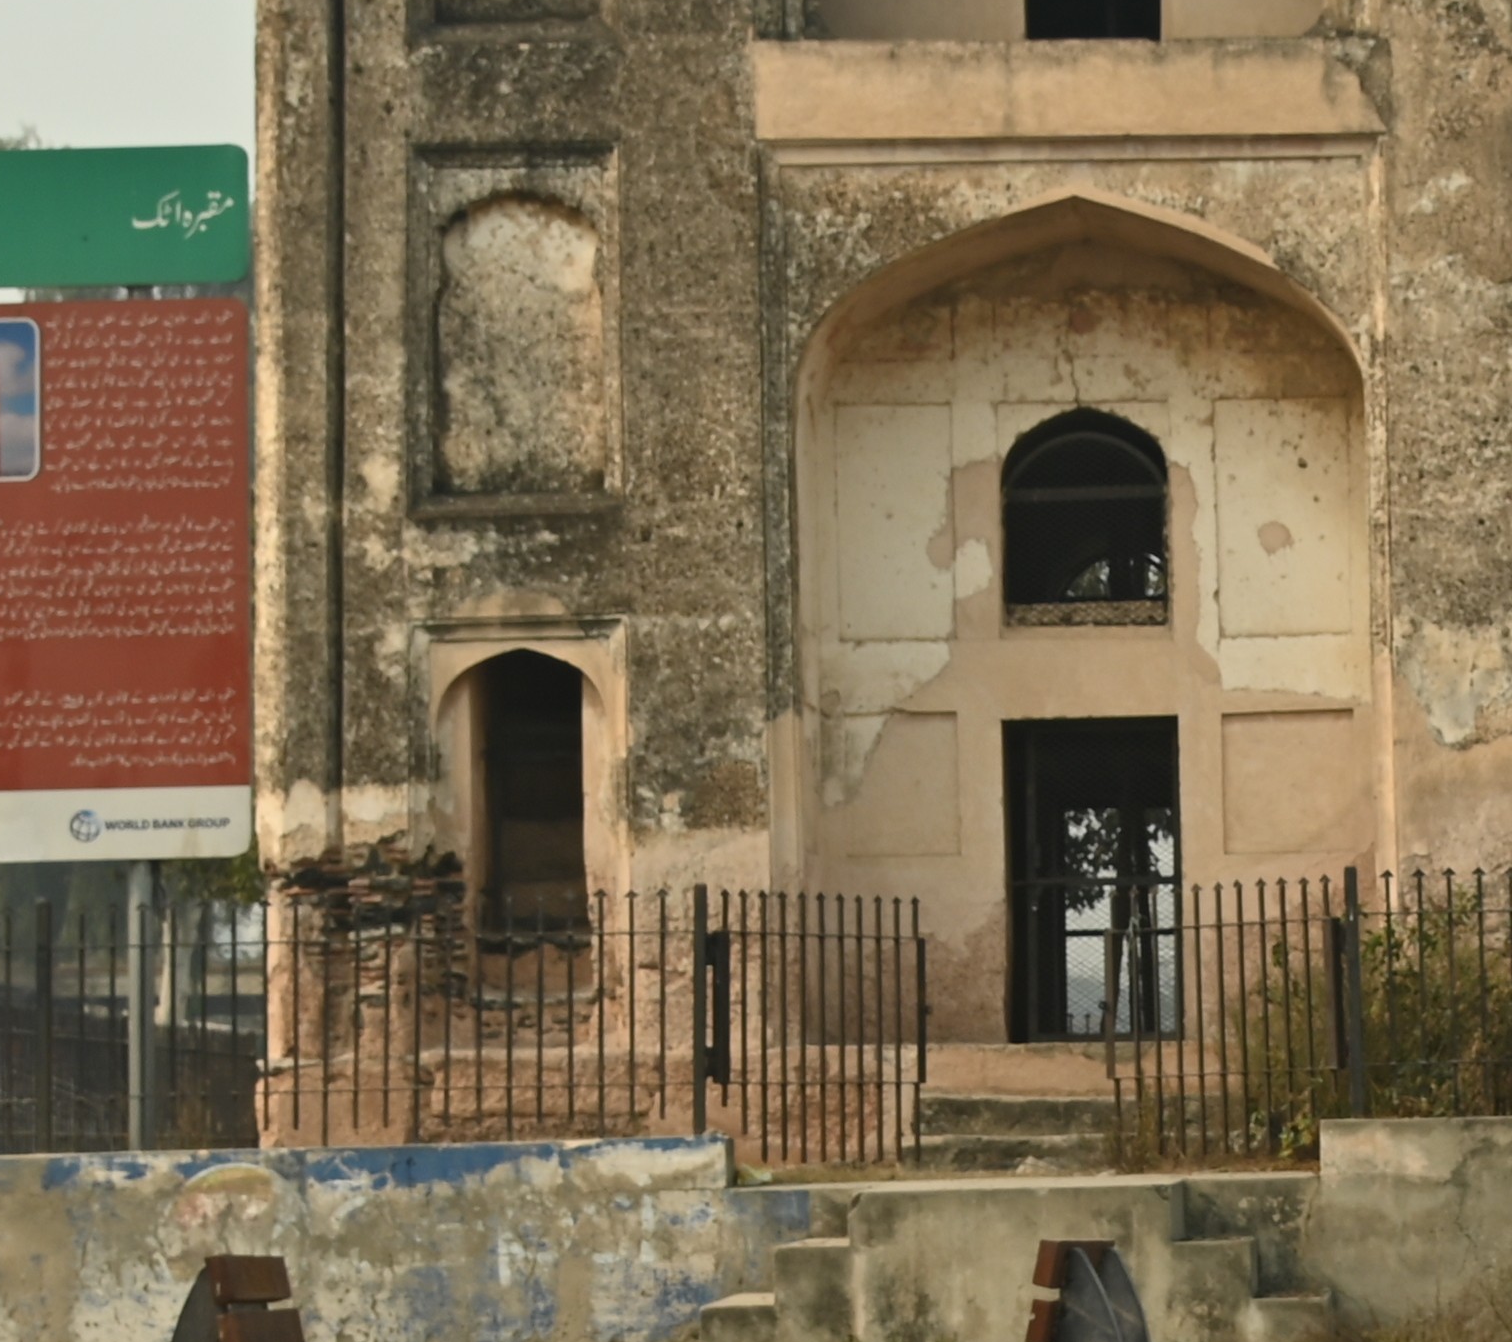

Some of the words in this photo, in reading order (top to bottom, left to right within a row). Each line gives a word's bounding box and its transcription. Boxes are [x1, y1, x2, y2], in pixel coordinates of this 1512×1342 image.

[131, 188, 181, 230] اٹک
[182, 190, 235, 239] مقبرہ
[105, 819, 150, 830] WORLD
[153, 818, 184, 829] BANK
[188, 817, 230, 828] GROUP
